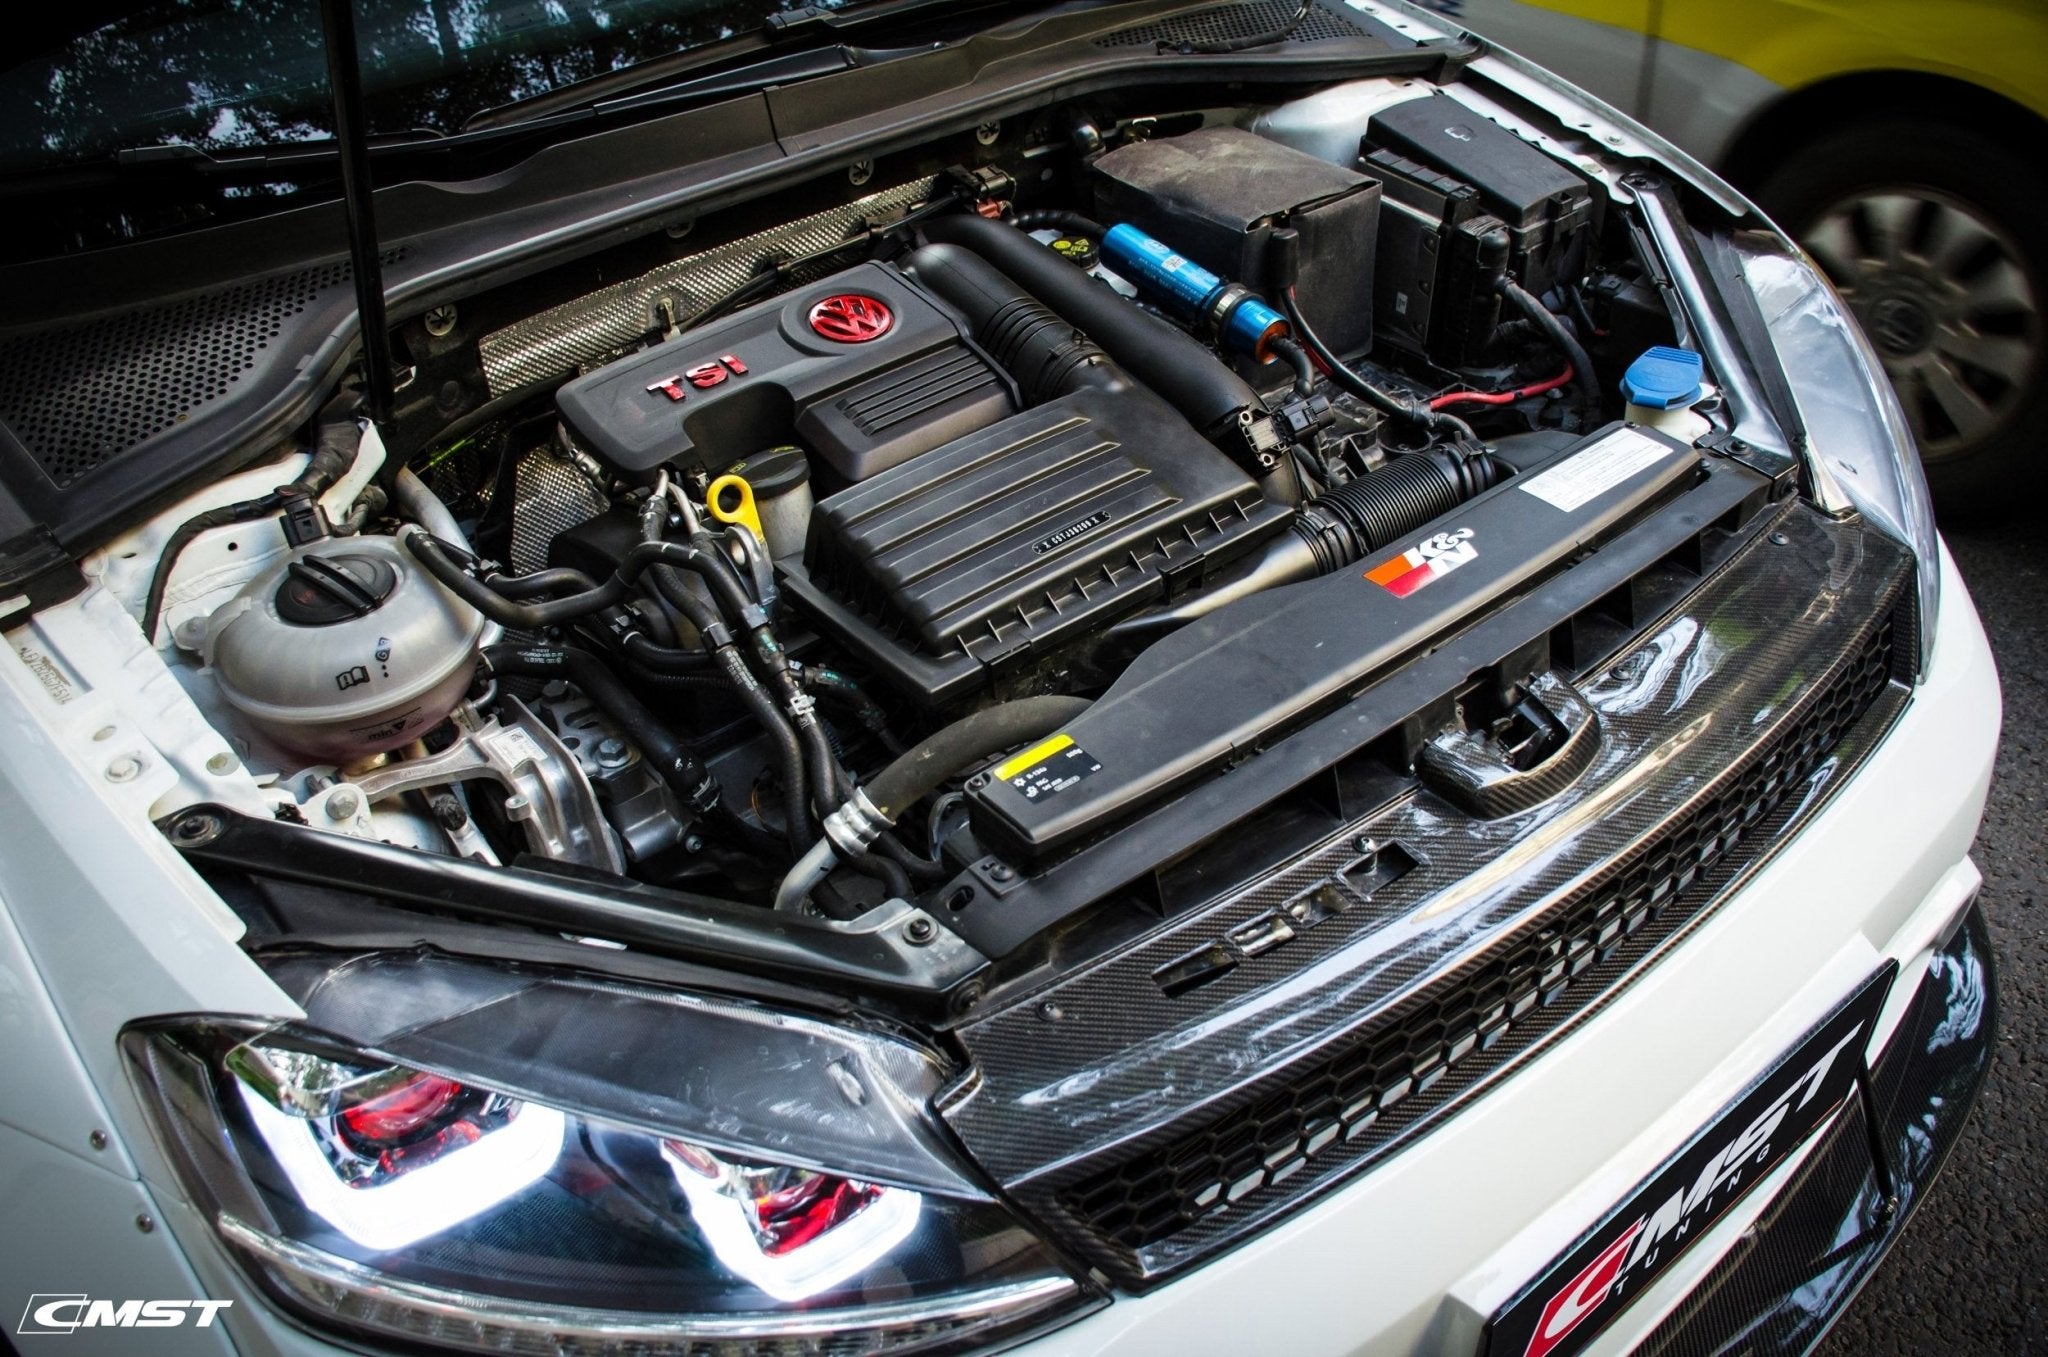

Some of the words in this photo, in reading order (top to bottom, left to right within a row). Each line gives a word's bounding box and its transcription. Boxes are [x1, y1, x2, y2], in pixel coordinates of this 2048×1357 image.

[646, 354, 749, 402] TSI
[1402, 528, 1479, 578] K&N
[368, 729, 394, 742] min
[1544, 1019, 1865, 1338] CMST
[1614, 1143, 1771, 1296] TUNING
